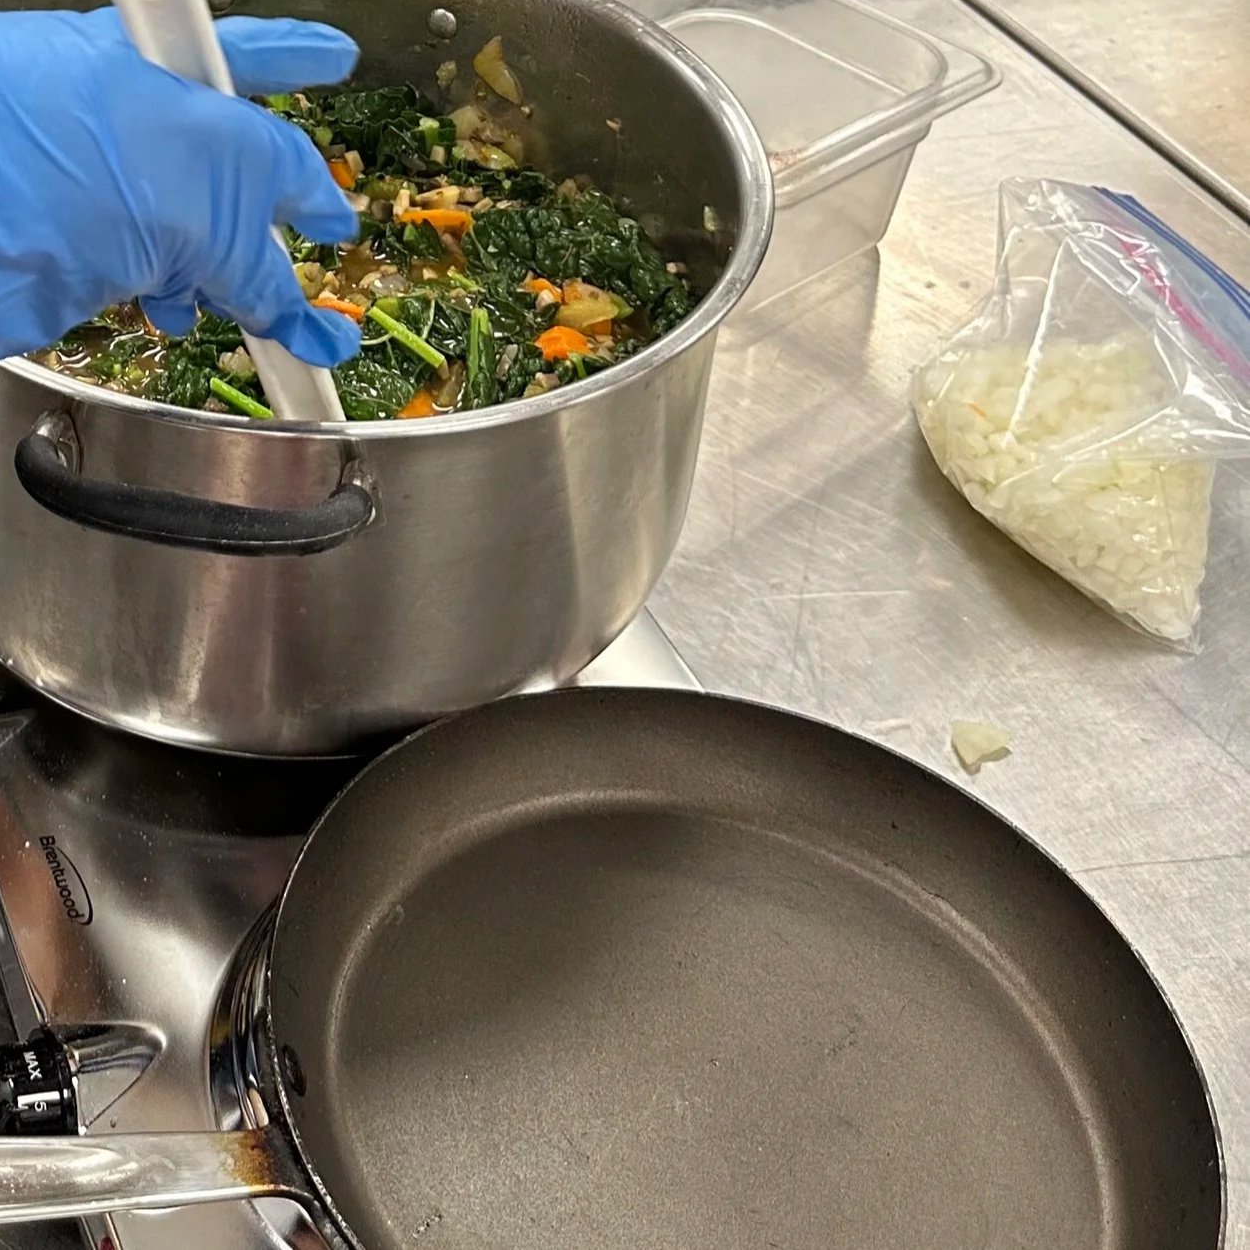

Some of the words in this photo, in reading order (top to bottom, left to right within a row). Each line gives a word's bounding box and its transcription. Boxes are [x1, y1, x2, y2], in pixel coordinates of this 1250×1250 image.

[38, 834, 86, 920] Brentwood
[22, 1050, 43, 1081] MAX
[34, 1100, 48, 1112] 5
